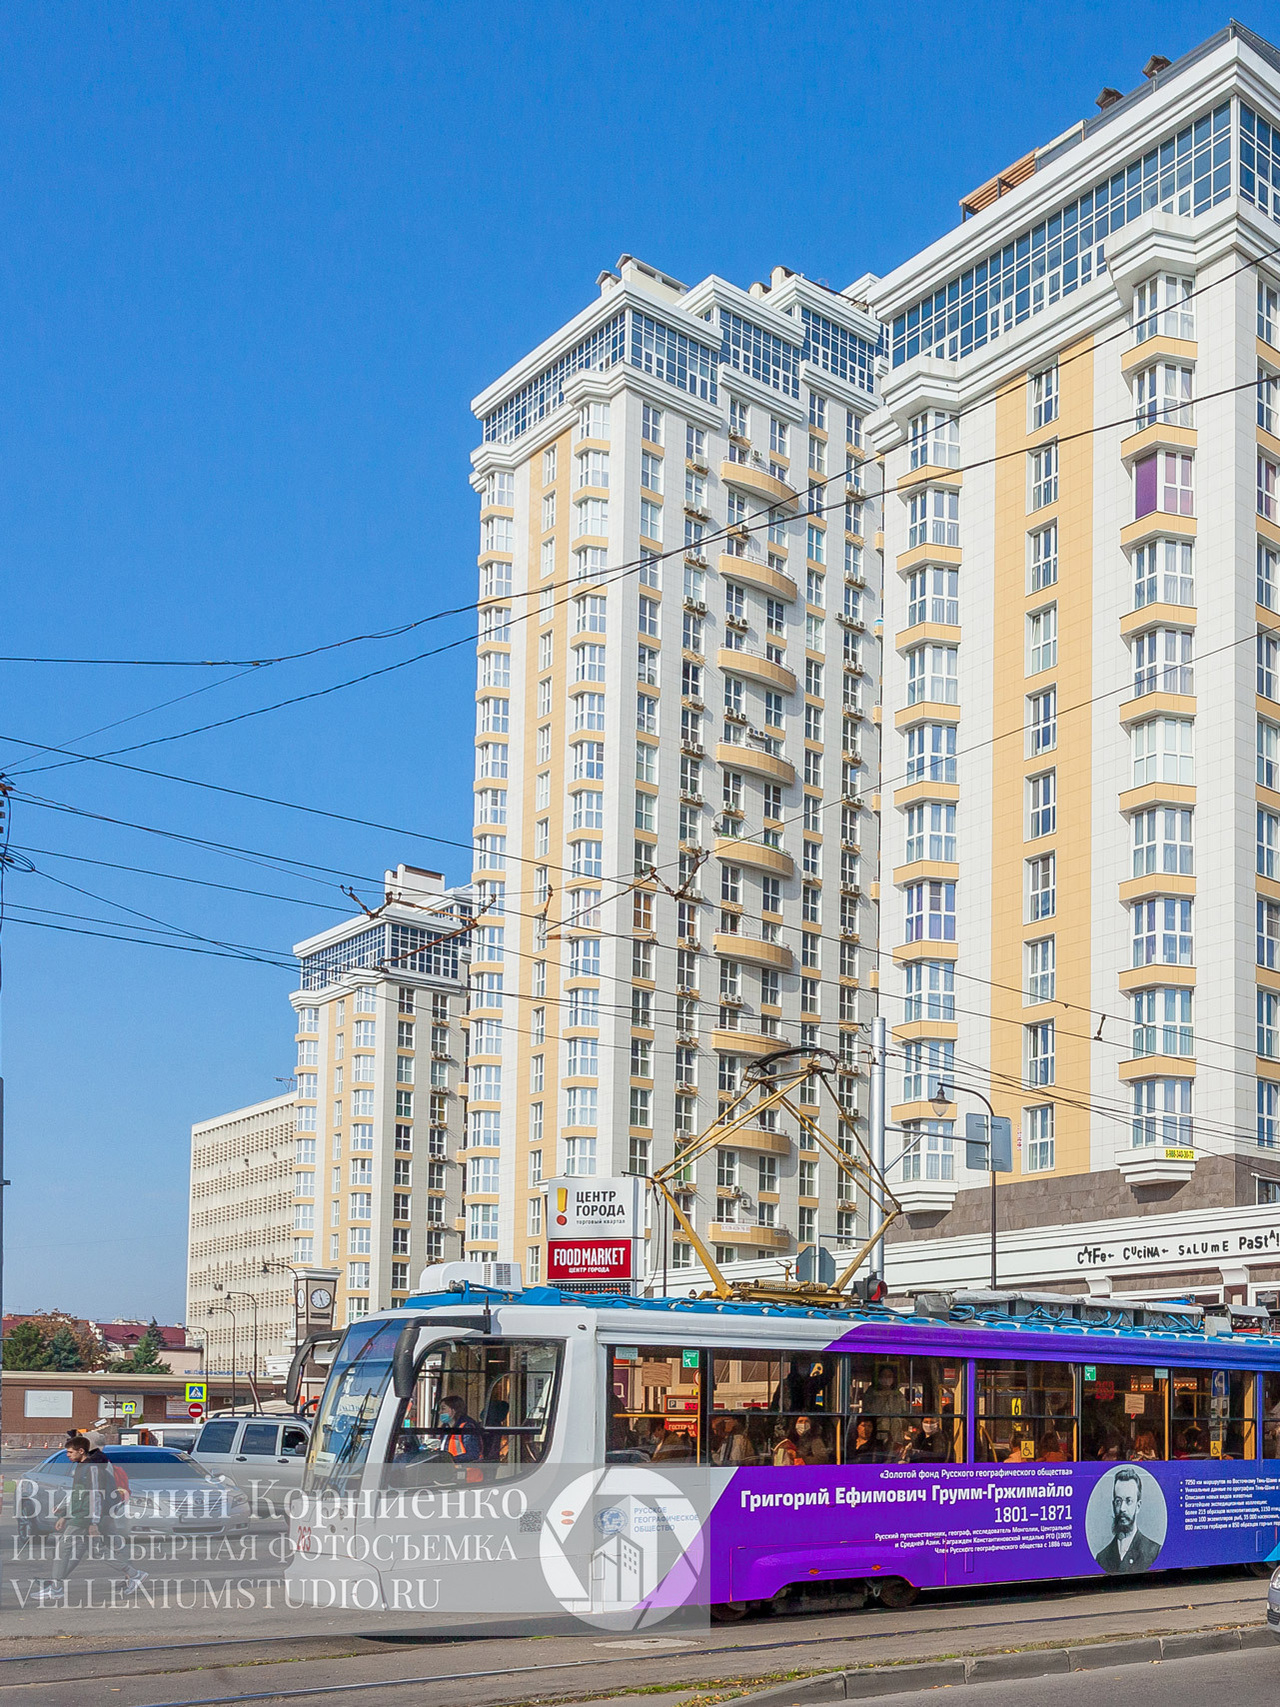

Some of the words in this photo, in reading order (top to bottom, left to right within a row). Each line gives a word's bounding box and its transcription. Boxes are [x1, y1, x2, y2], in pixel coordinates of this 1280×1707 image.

[576, 1191, 617, 1203] ЦЕНТР
[576, 1204, 626, 1217] ГОРОДА
[554, 1247, 626, 1267] FOODMARKET
[880, 1470, 917, 1479] «Золотой
[918, 1470, 940, 1480] фонд
[941, 1469, 975, 1480] Русского
[975, 1468, 1036, 1479] географического
[1037, 1468, 1073, 1477] общества»
[741, 1488, 830, 1512] Григорий
[836, 1487, 927, 1508] Ефимович
[932, 1483, 1073, 1505] Грумм-Гржимайло
[634, 1514, 699, 1524] ГЕОГРАФИЧЕСКОЕ
[634, 1525, 676, 1533] ОБЩЕСТВО
[297, 1526, 312, 1552] 263
